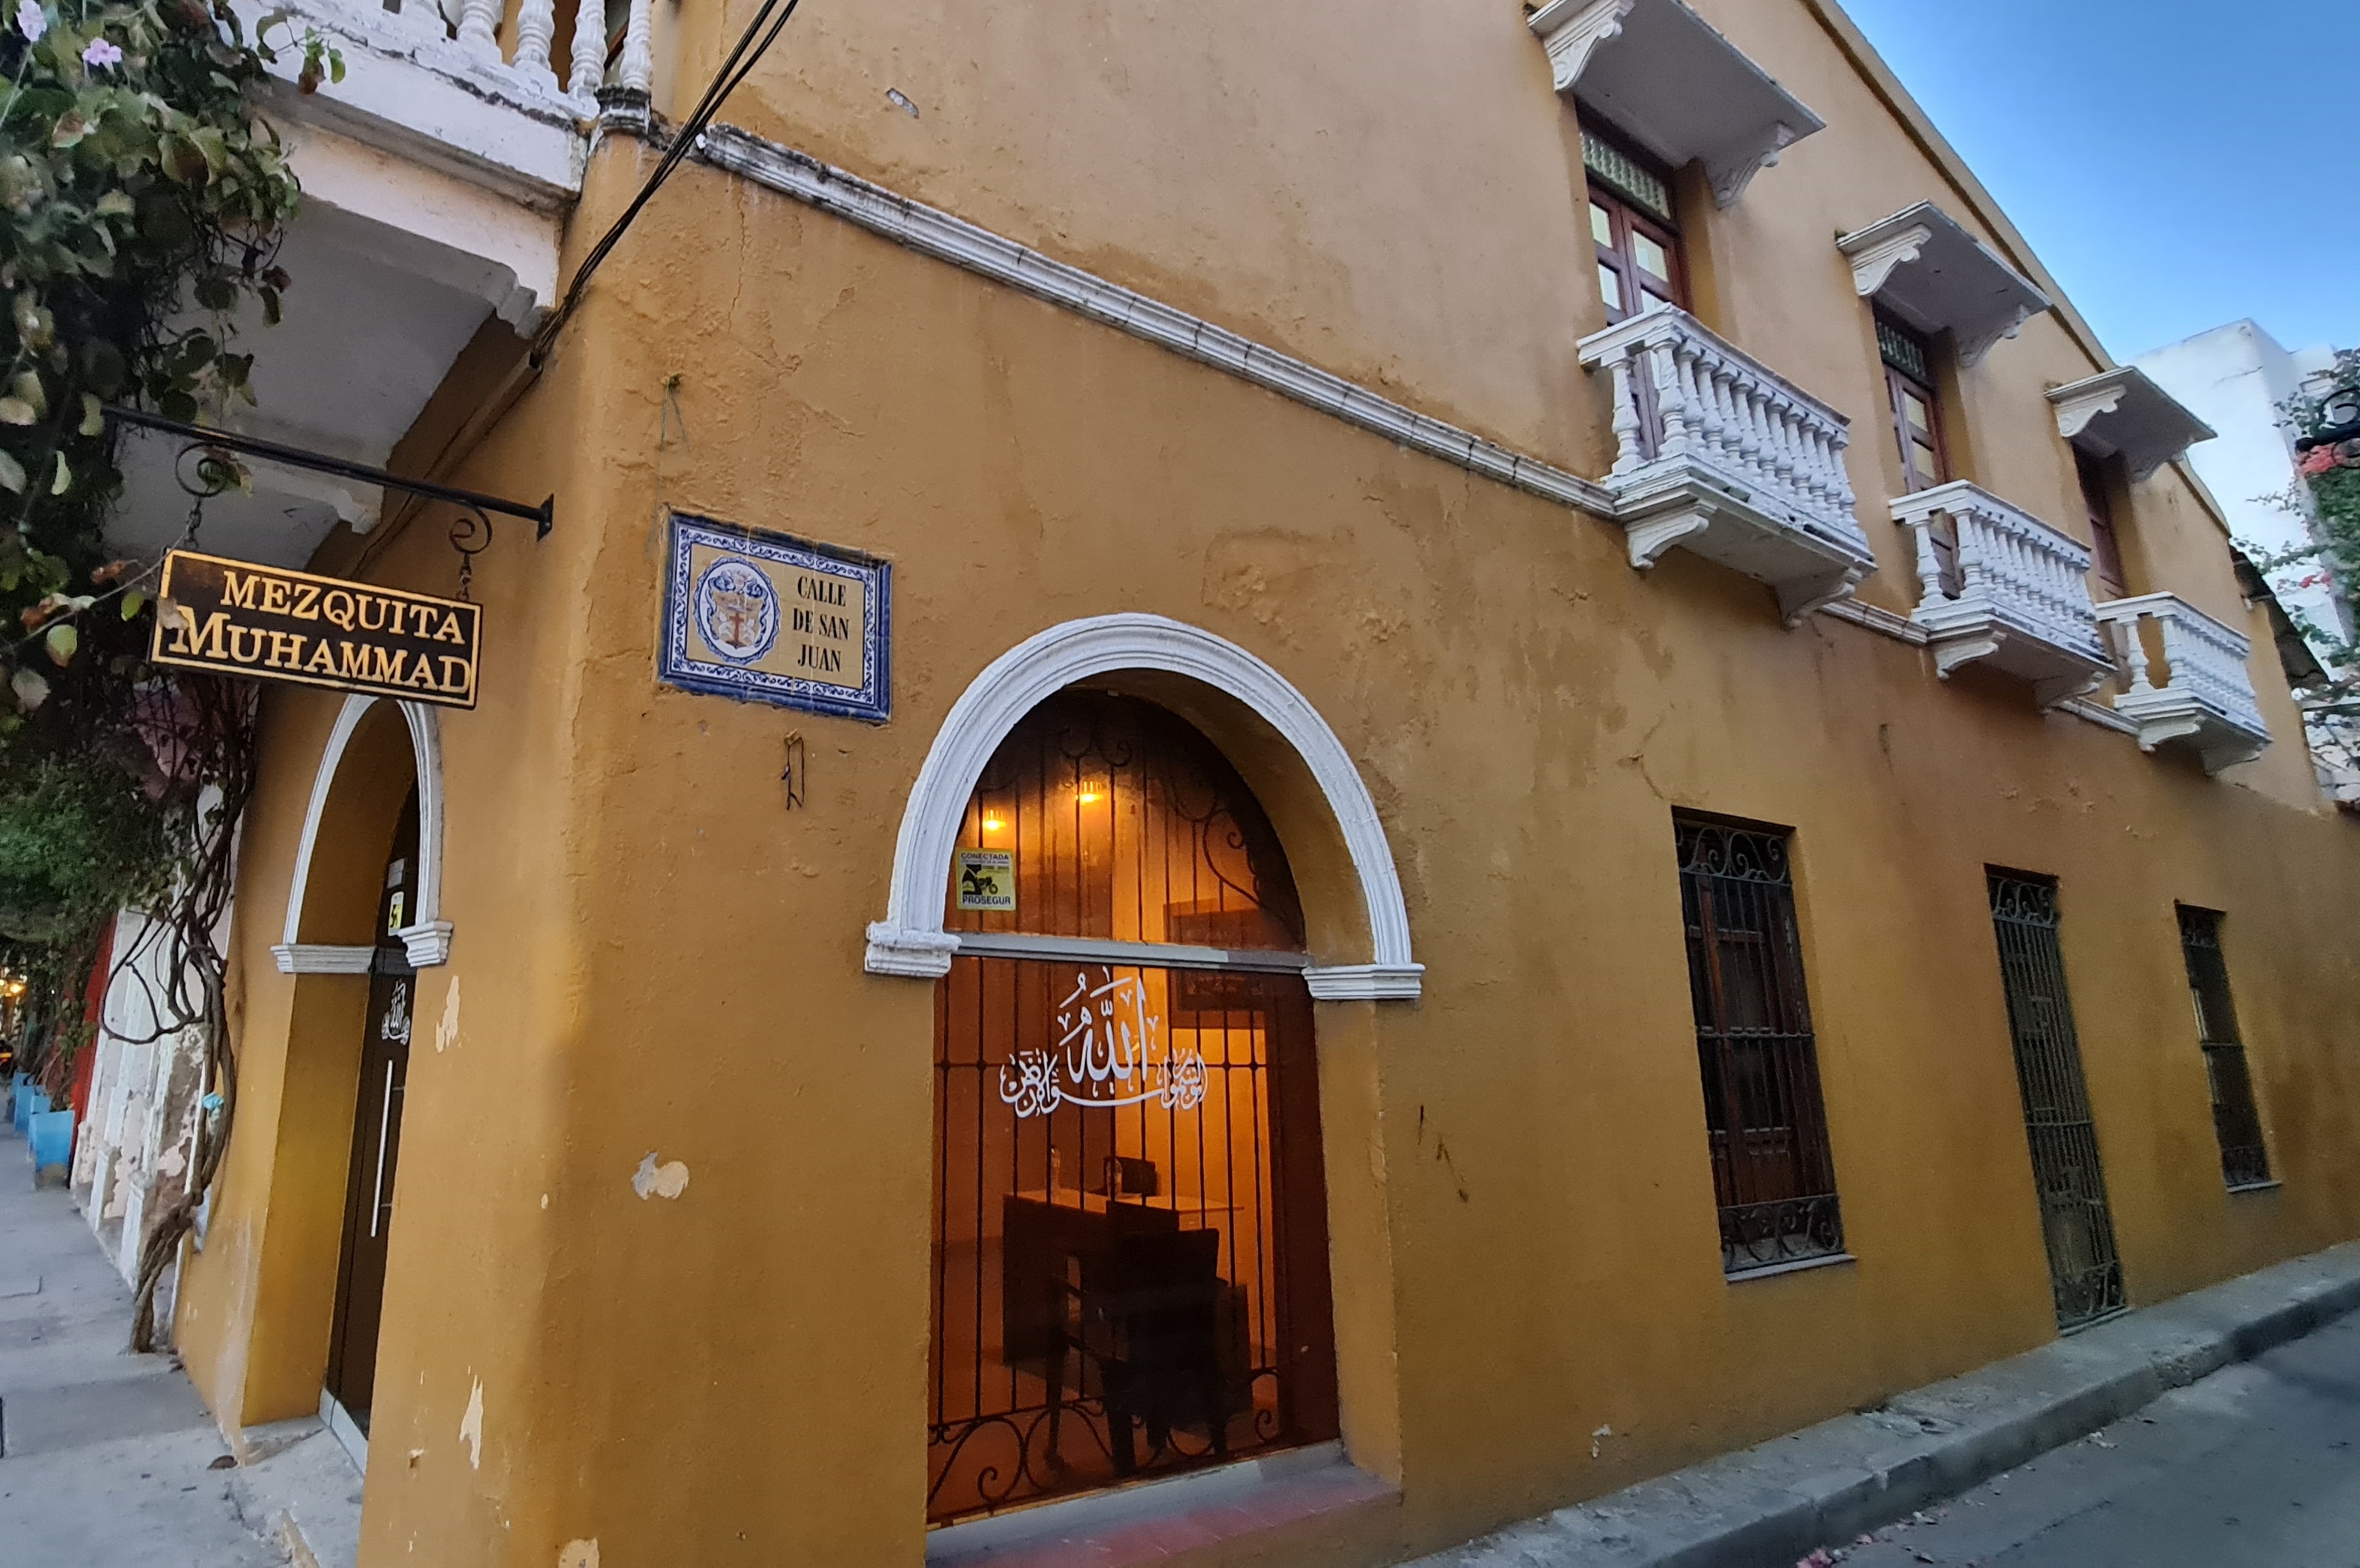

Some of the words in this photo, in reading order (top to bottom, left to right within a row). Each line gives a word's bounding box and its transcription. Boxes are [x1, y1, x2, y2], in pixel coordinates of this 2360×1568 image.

[797, 575, 846, 607] CALLE
[220, 570, 465, 645] MEZQUITA
[793, 607, 813, 633] DE
[818, 613, 850, 640] SAN
[168, 605, 471, 694] MUHAMMAD
[797, 644, 842, 672] JUAN
[962, 896, 1011, 905] PROSEGUR
